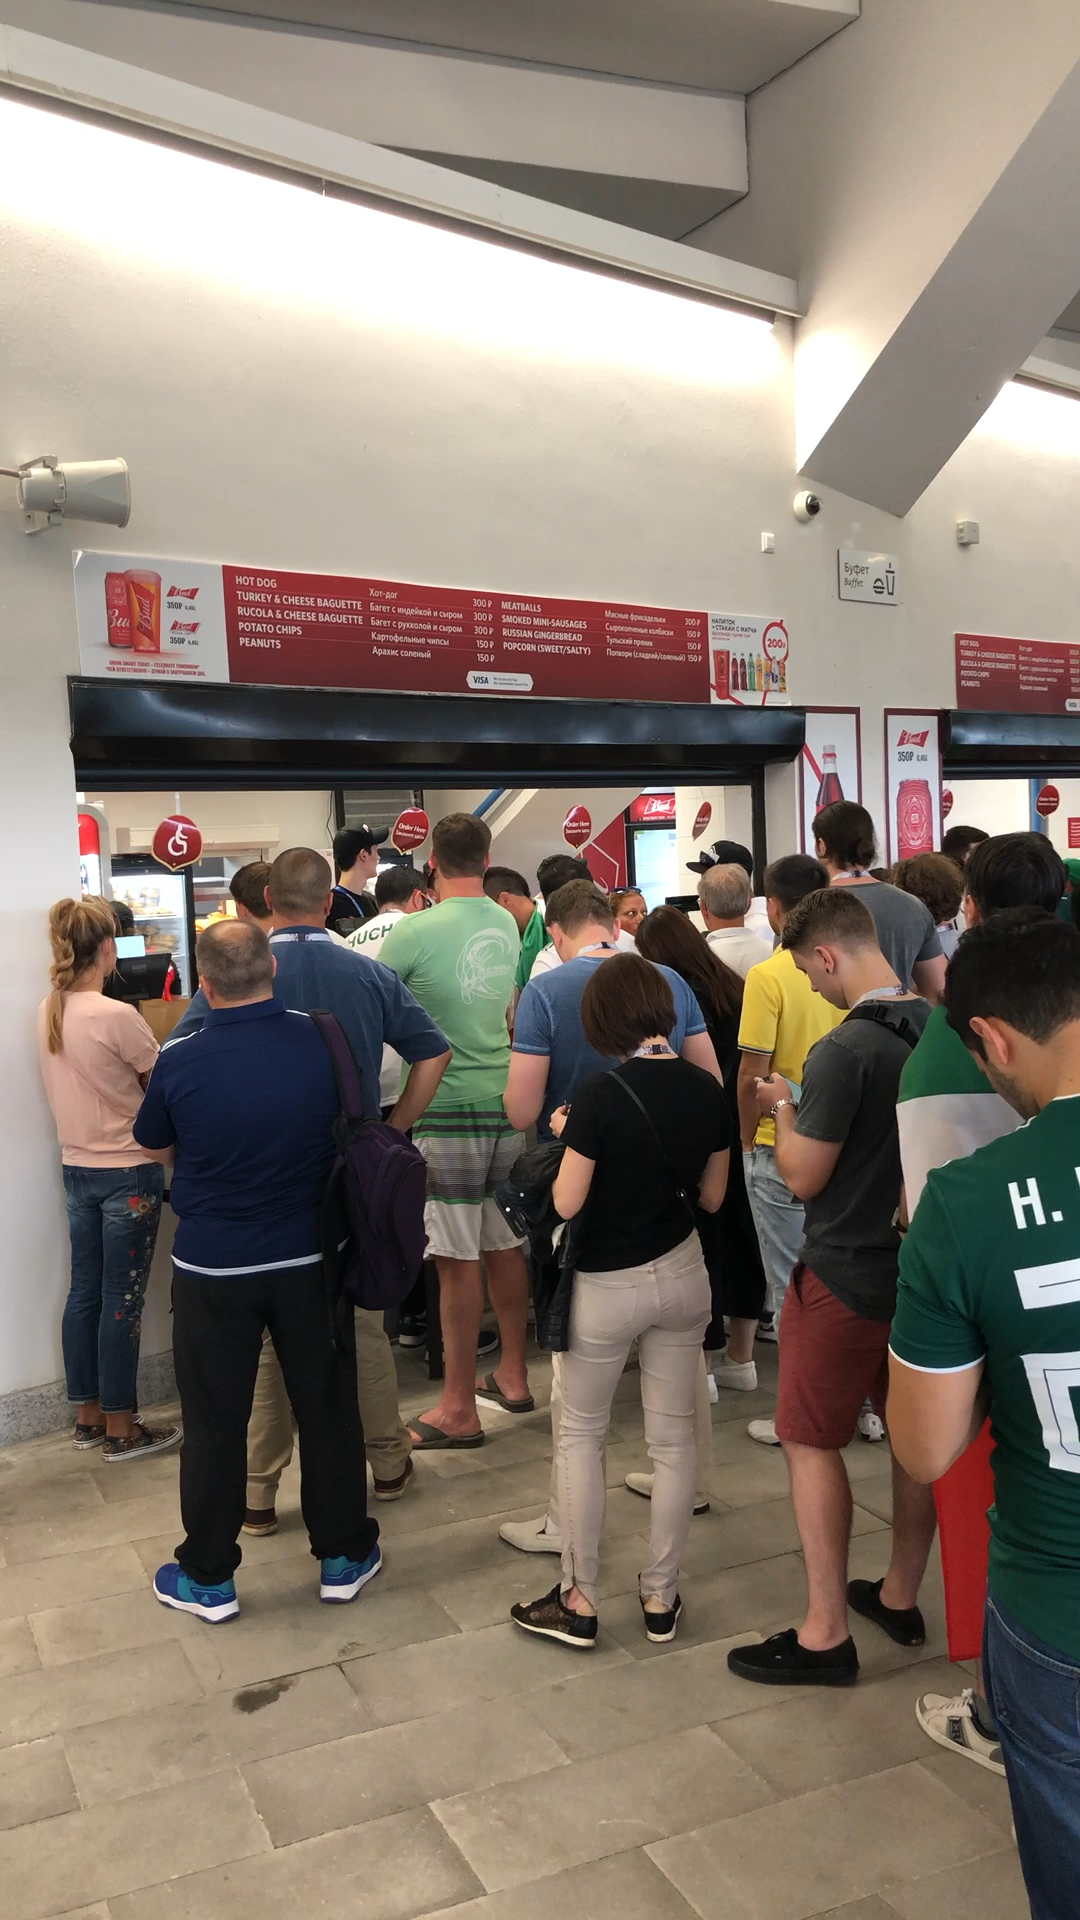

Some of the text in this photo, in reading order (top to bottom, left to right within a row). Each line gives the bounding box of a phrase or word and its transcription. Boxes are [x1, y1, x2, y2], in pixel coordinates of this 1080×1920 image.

[844, 562, 870, 576] Буфет
[235, 575, 277, 588] HOT DOG
[844, 577, 864, 589] Buffet
[369, 588, 398, 600] Хот-дог
[236, 591, 363, 610] TURKEY & CHEESE BAGUETTE
[472, 598, 487, 608] 300
[370, 602, 390, 613] Багет
[397, 607, 432, 617] индейкой
[439, 611, 463, 620] сыром
[501, 601, 542, 613] MEATBALLS
[139, 595, 152, 632] Bud
[237, 606, 363, 625] RUCOLA & CHEESE BAGUETTE
[473, 612, 488, 621] 300
[370, 617, 391, 627] Багет
[398, 621, 431, 631] рукколой
[439, 625, 463, 634] сыром
[501, 614, 588, 629] SMOKED MINI-SAUSAGES
[684, 618, 696, 626] 300
[238, 622, 302, 635] POTATO CHIPS
[474, 626, 488, 635] 300
[686, 630, 696, 638] 150
[371, 631, 450, 646] Картофельные чипсы
[502, 628, 583, 642] RUSSIAN GINGERBREAD
[239, 637, 281, 649] PEANUTS
[476, 640, 489, 649] 150
[503, 641, 591, 655] POPCORN (SWEET/SALTY)
[687, 642, 697, 650] 150
[372, 646, 432, 659] Арахис соленый
[477, 653, 489, 662] 150
[606, 648, 632, 658] Попкорн
[687, 654, 697, 662] 150
[472, 676, 489, 684] VISA
[398, 823, 426, 833] Order Here
[1008, 1177, 1064, 1229] H.
